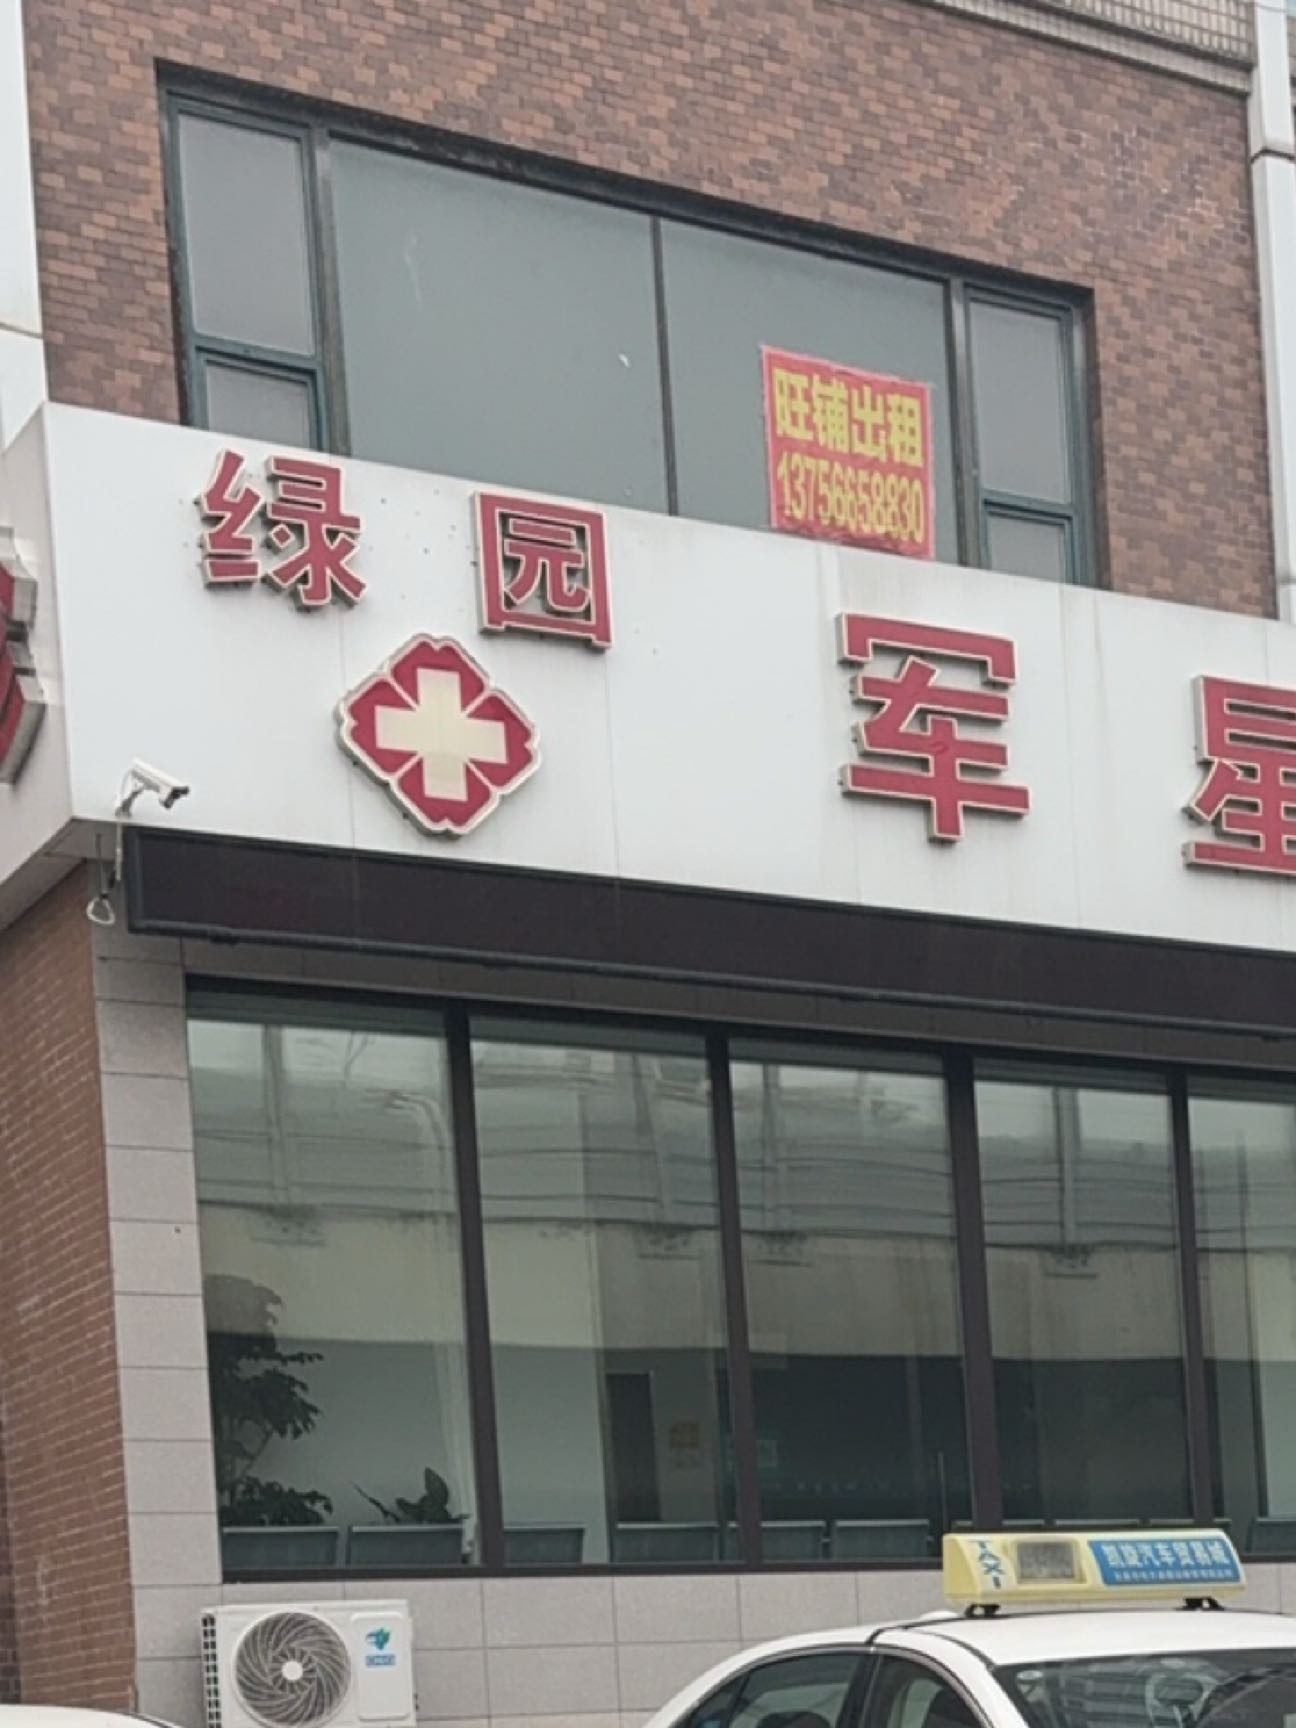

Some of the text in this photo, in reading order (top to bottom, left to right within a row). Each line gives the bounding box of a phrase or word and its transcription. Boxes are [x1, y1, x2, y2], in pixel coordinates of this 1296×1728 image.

[772, 367, 923, 468] 旺铺出租
[197, 450, 613, 650] 绿园
[966, 1539, 1005, 1589] TAXI
